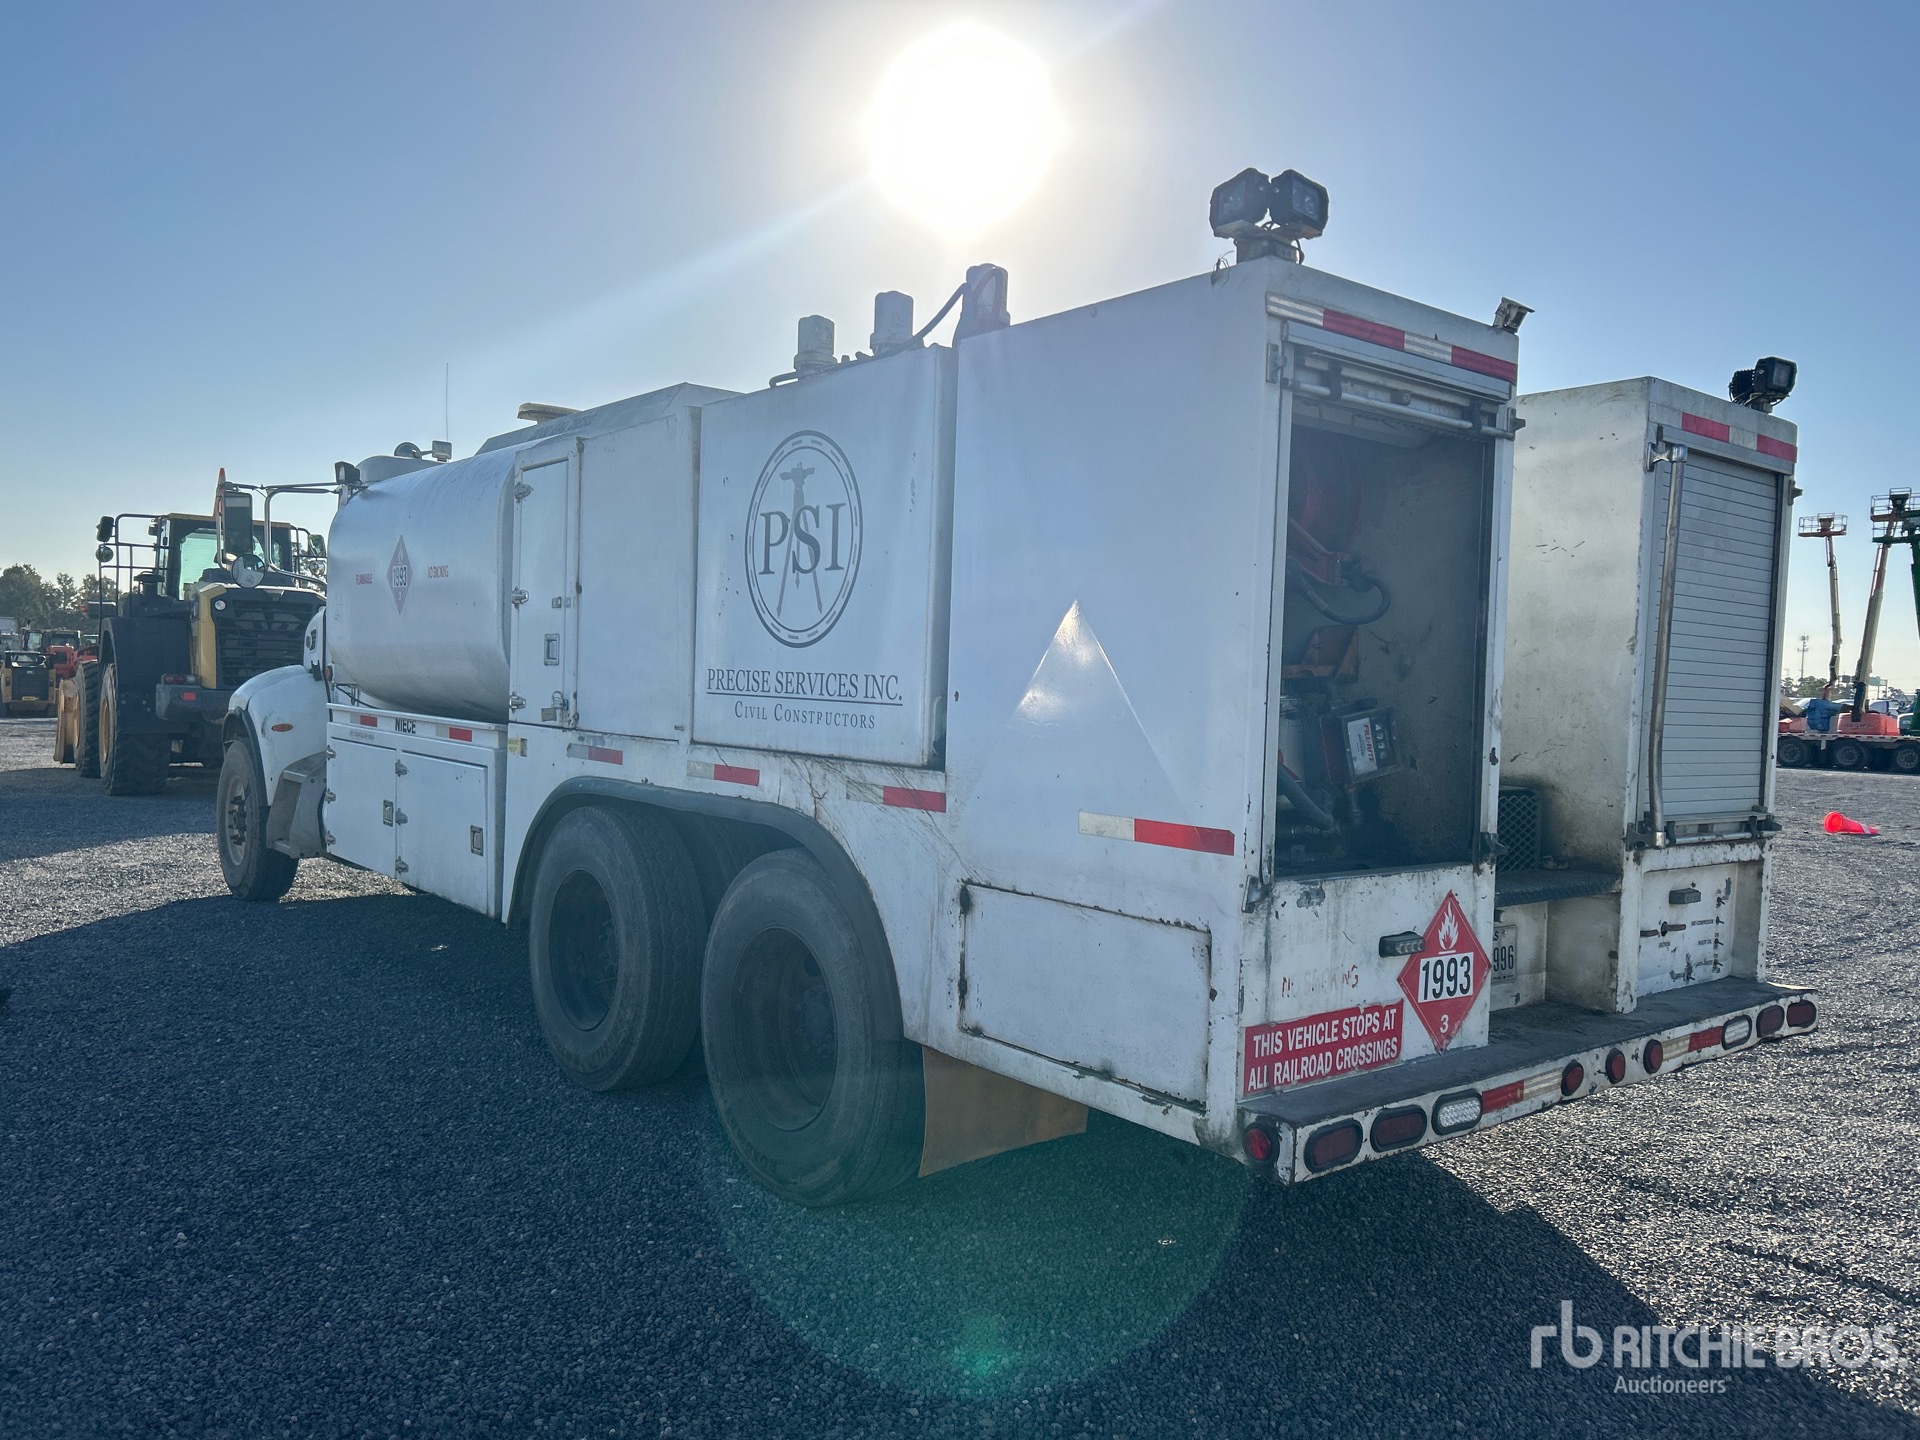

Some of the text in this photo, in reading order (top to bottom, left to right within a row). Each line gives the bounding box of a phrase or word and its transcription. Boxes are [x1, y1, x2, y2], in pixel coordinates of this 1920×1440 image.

[758, 502, 847, 575] PSI
[393, 567, 407, 587] 1993
[707, 668, 903, 701] PRECISE SERVICES INC.
[394, 718, 417, 734] NIECE
[734, 700, 768, 721] CIVIL
[1422, 955, 1472, 1001] 1993
[1253, 1008, 1397, 1059] THIS VEHICLE STOPS AT
[1440, 1014, 1449, 1034] 3
[1274, 1050, 1333, 1086] RAILROAD
[1335, 1036, 1398, 1071] CROSSINGS
